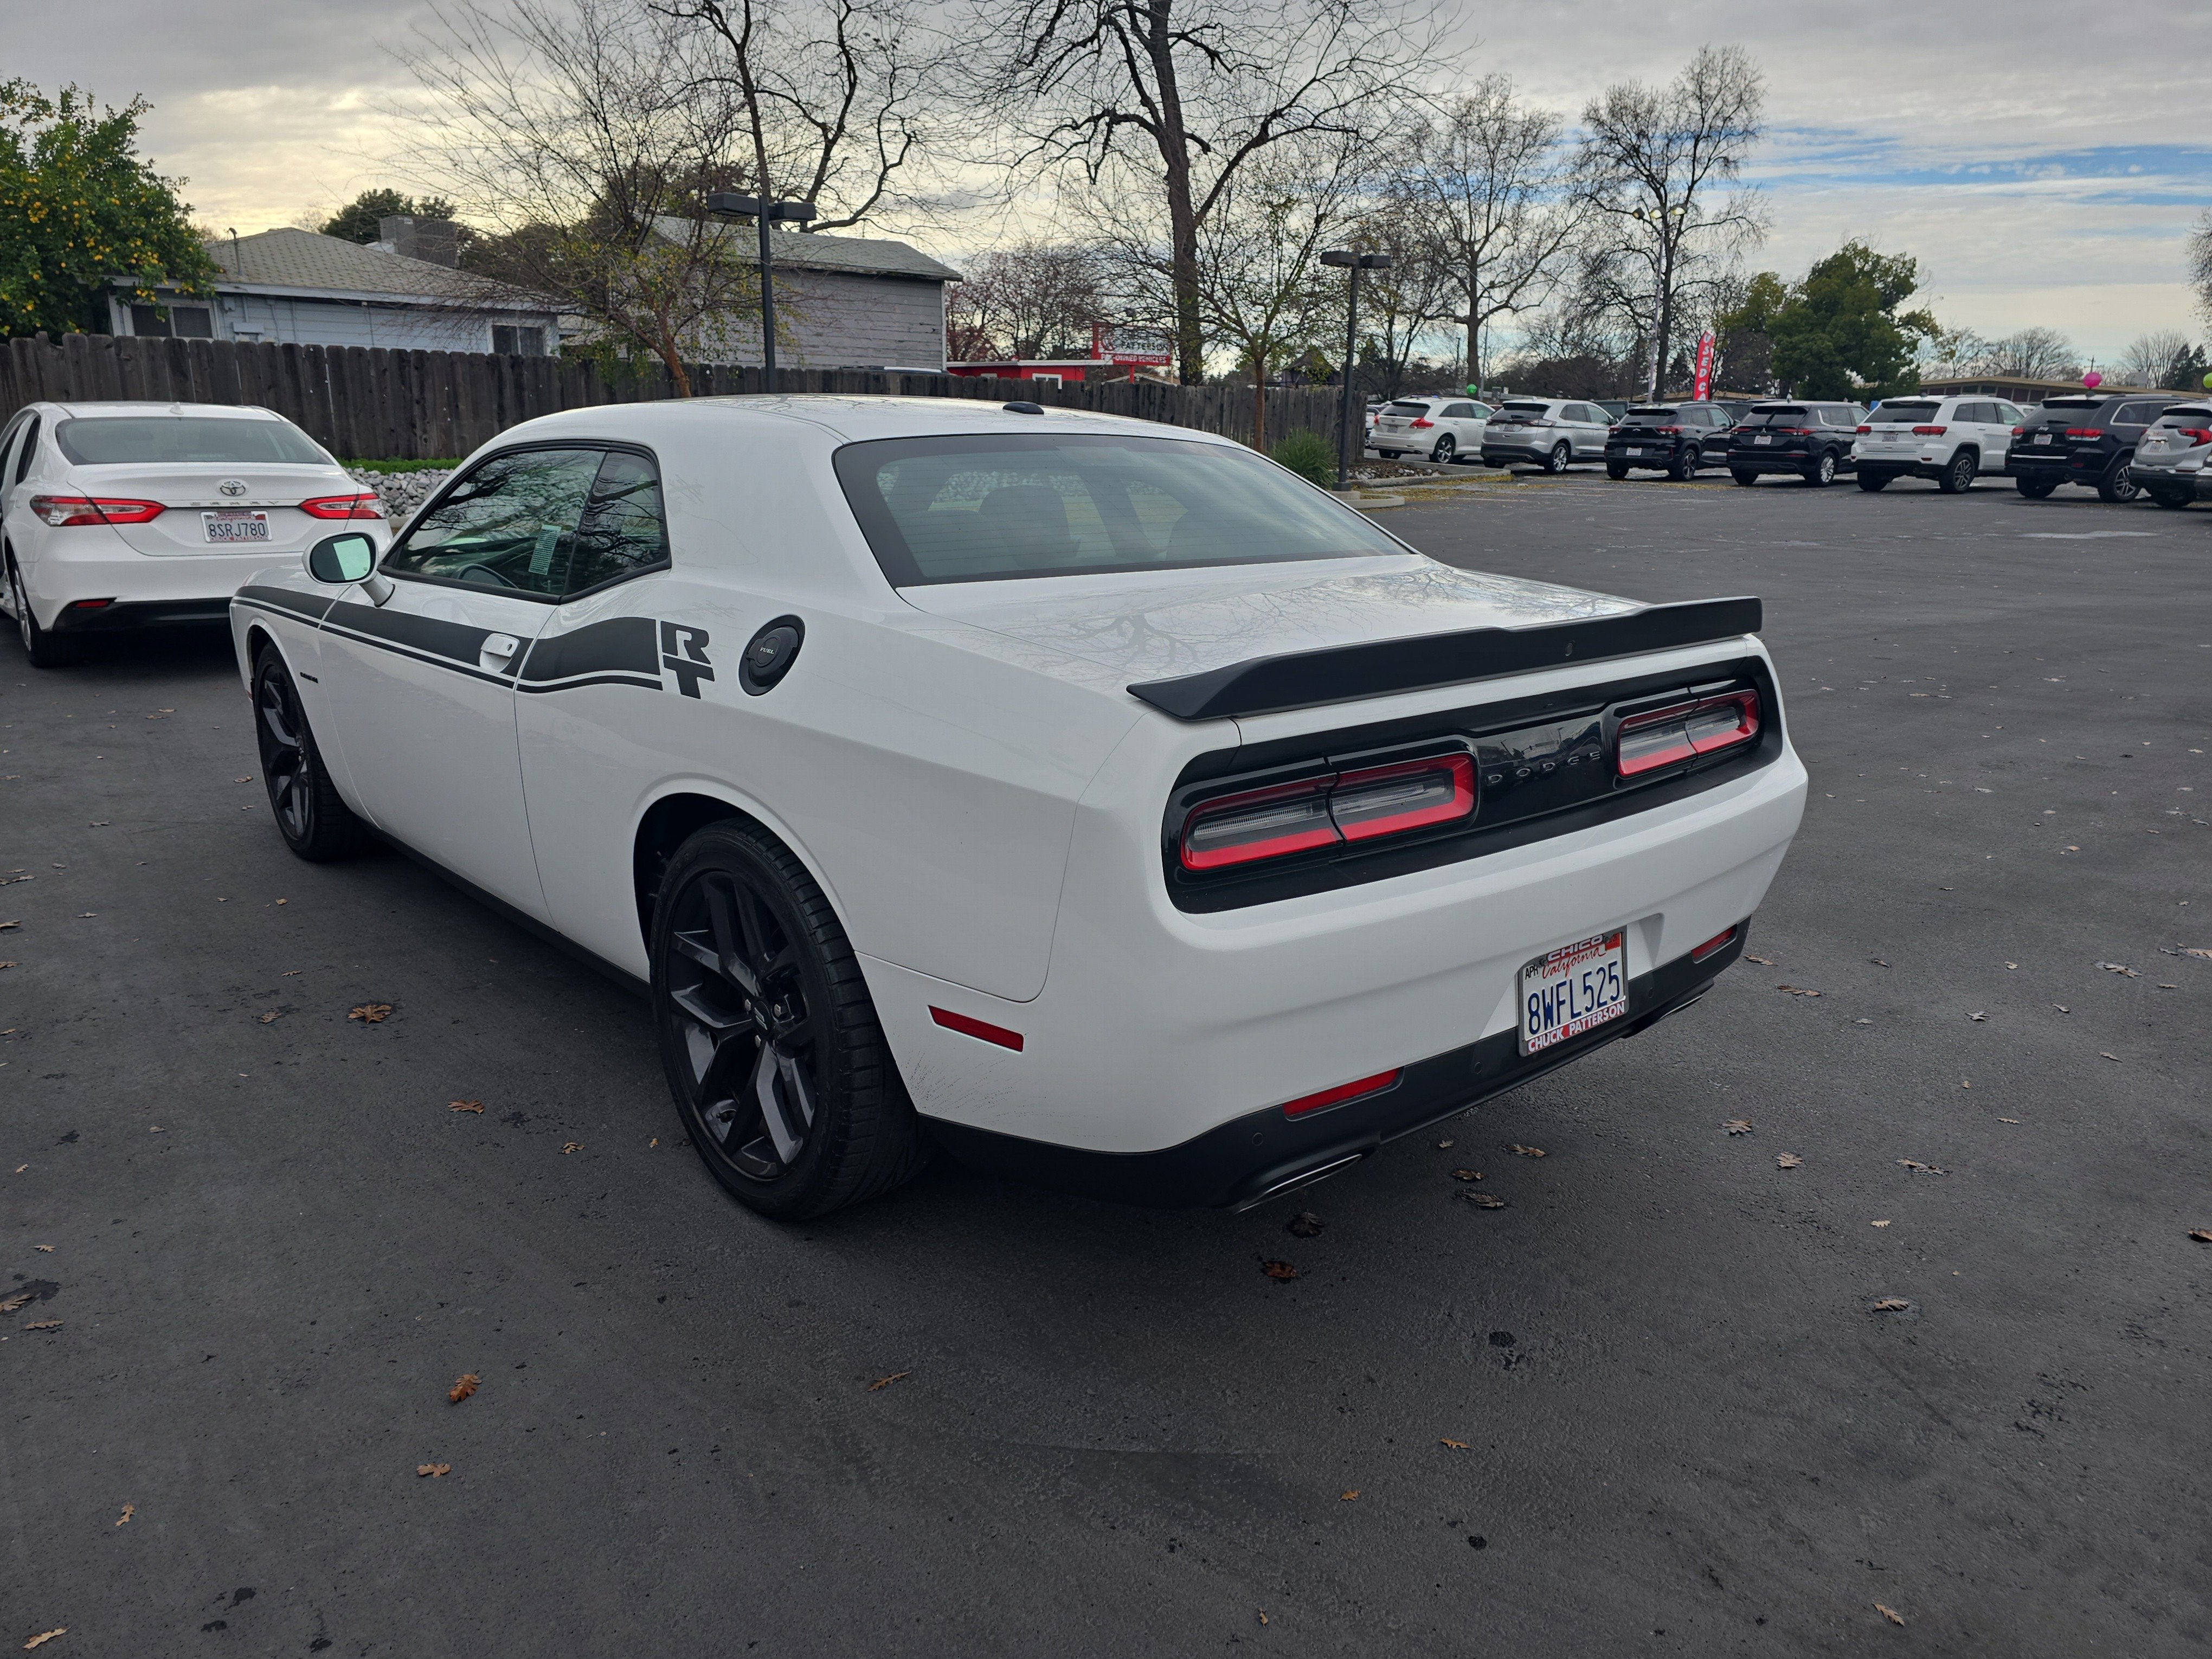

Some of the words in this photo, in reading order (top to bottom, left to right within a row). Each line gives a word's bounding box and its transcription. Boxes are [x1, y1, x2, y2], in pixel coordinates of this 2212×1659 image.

[1699, 335, 1712, 378] USED
[208, 523, 266, 537] 8SRJ780
[1488, 751, 1600, 784] DODGE
[1542, 947, 1606, 979] California
[1547, 935, 1603, 962] CHICO
[1528, 960, 1620, 1035] 8WFL525
[1528, 1030, 1564, 1052] CHUCK
[1569, 1001, 1625, 1036] PATTERSON
